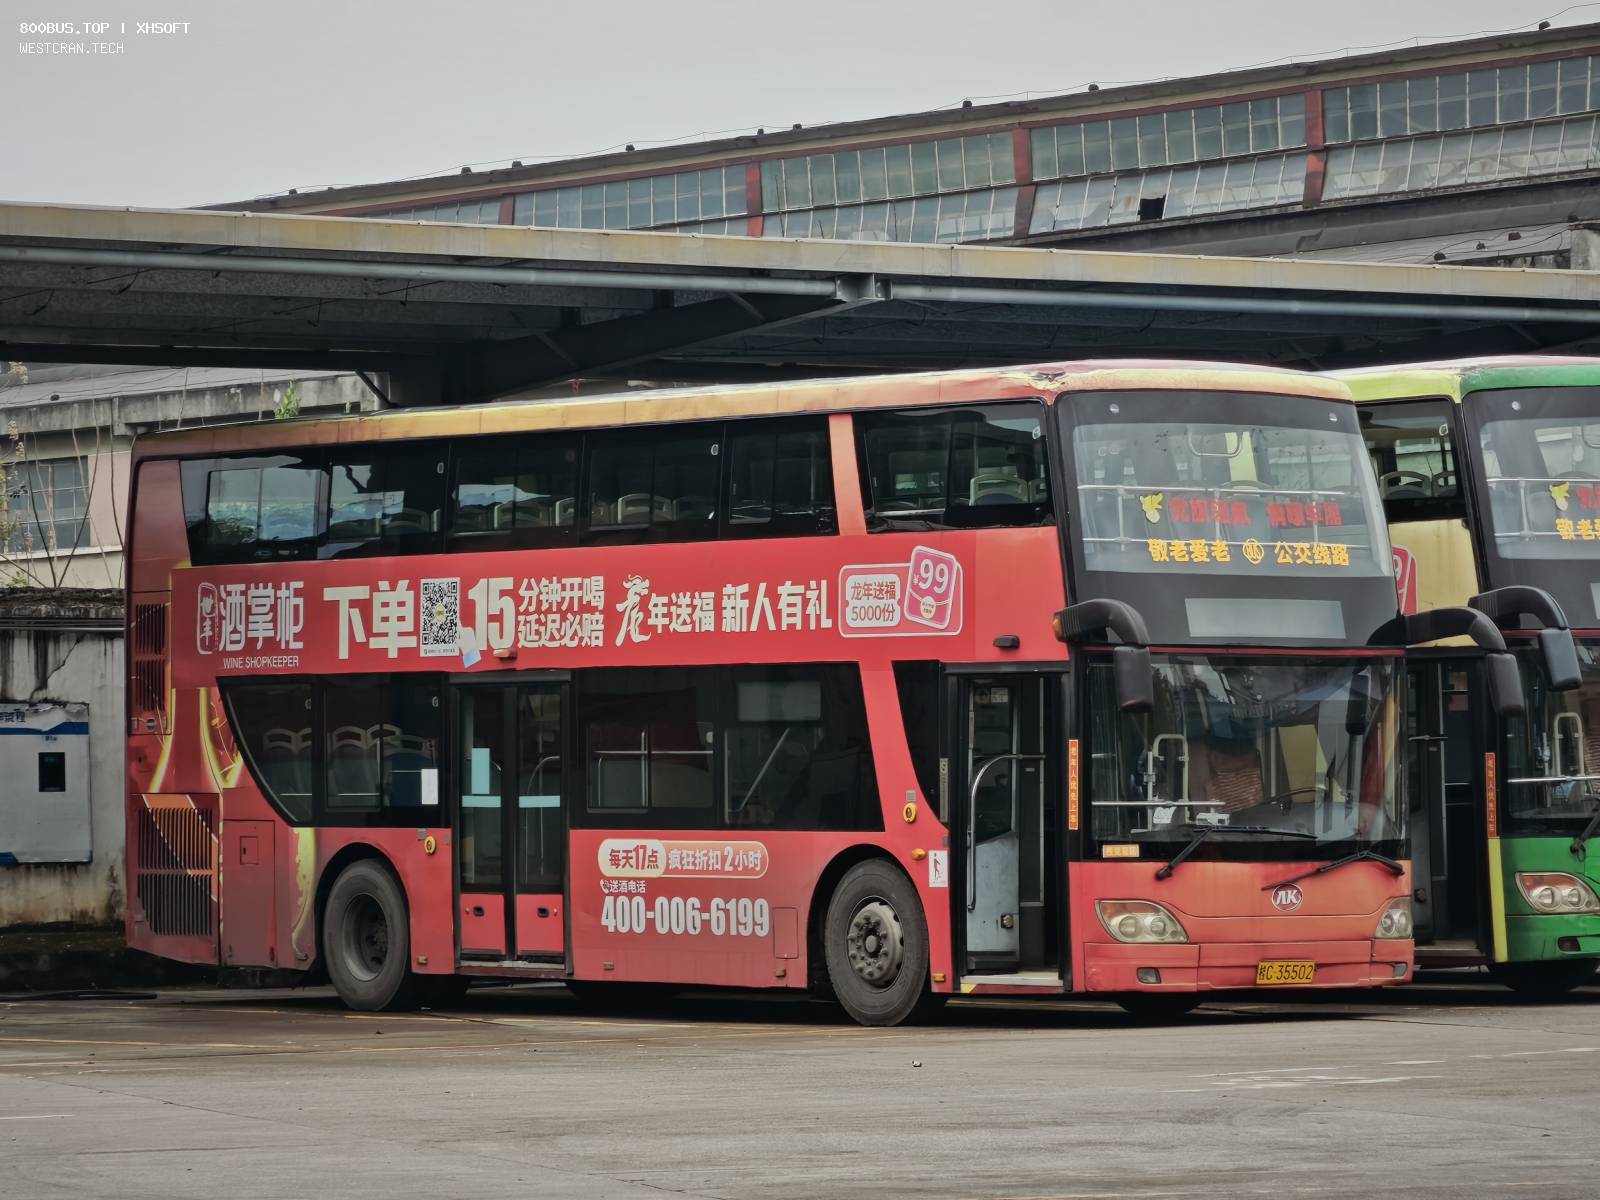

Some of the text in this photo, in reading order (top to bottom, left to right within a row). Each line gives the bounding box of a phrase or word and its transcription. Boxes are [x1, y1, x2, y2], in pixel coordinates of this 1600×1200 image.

[1147, 538, 1350, 566] 敬老爱老 公交线路
[518, 576, 604, 612] 分钟开喝
[721, 580, 833, 633] 新人有礼
[851, 581, 896, 601] 龙年送福
[219, 581, 304, 652] 酒掌柜
[323, 579, 417, 660] 下单
[468, 577, 516, 651] 15
[517, 612, 604, 648] 延迟必赔
[851, 603, 896, 622] 5000份
[223, 655, 299, 669] WINE SHOPKEEPER
[609, 845, 659, 870] 每天17点
[609, 880, 646, 893] 送酒电话
[601, 896, 769, 937] 400-006-6199
